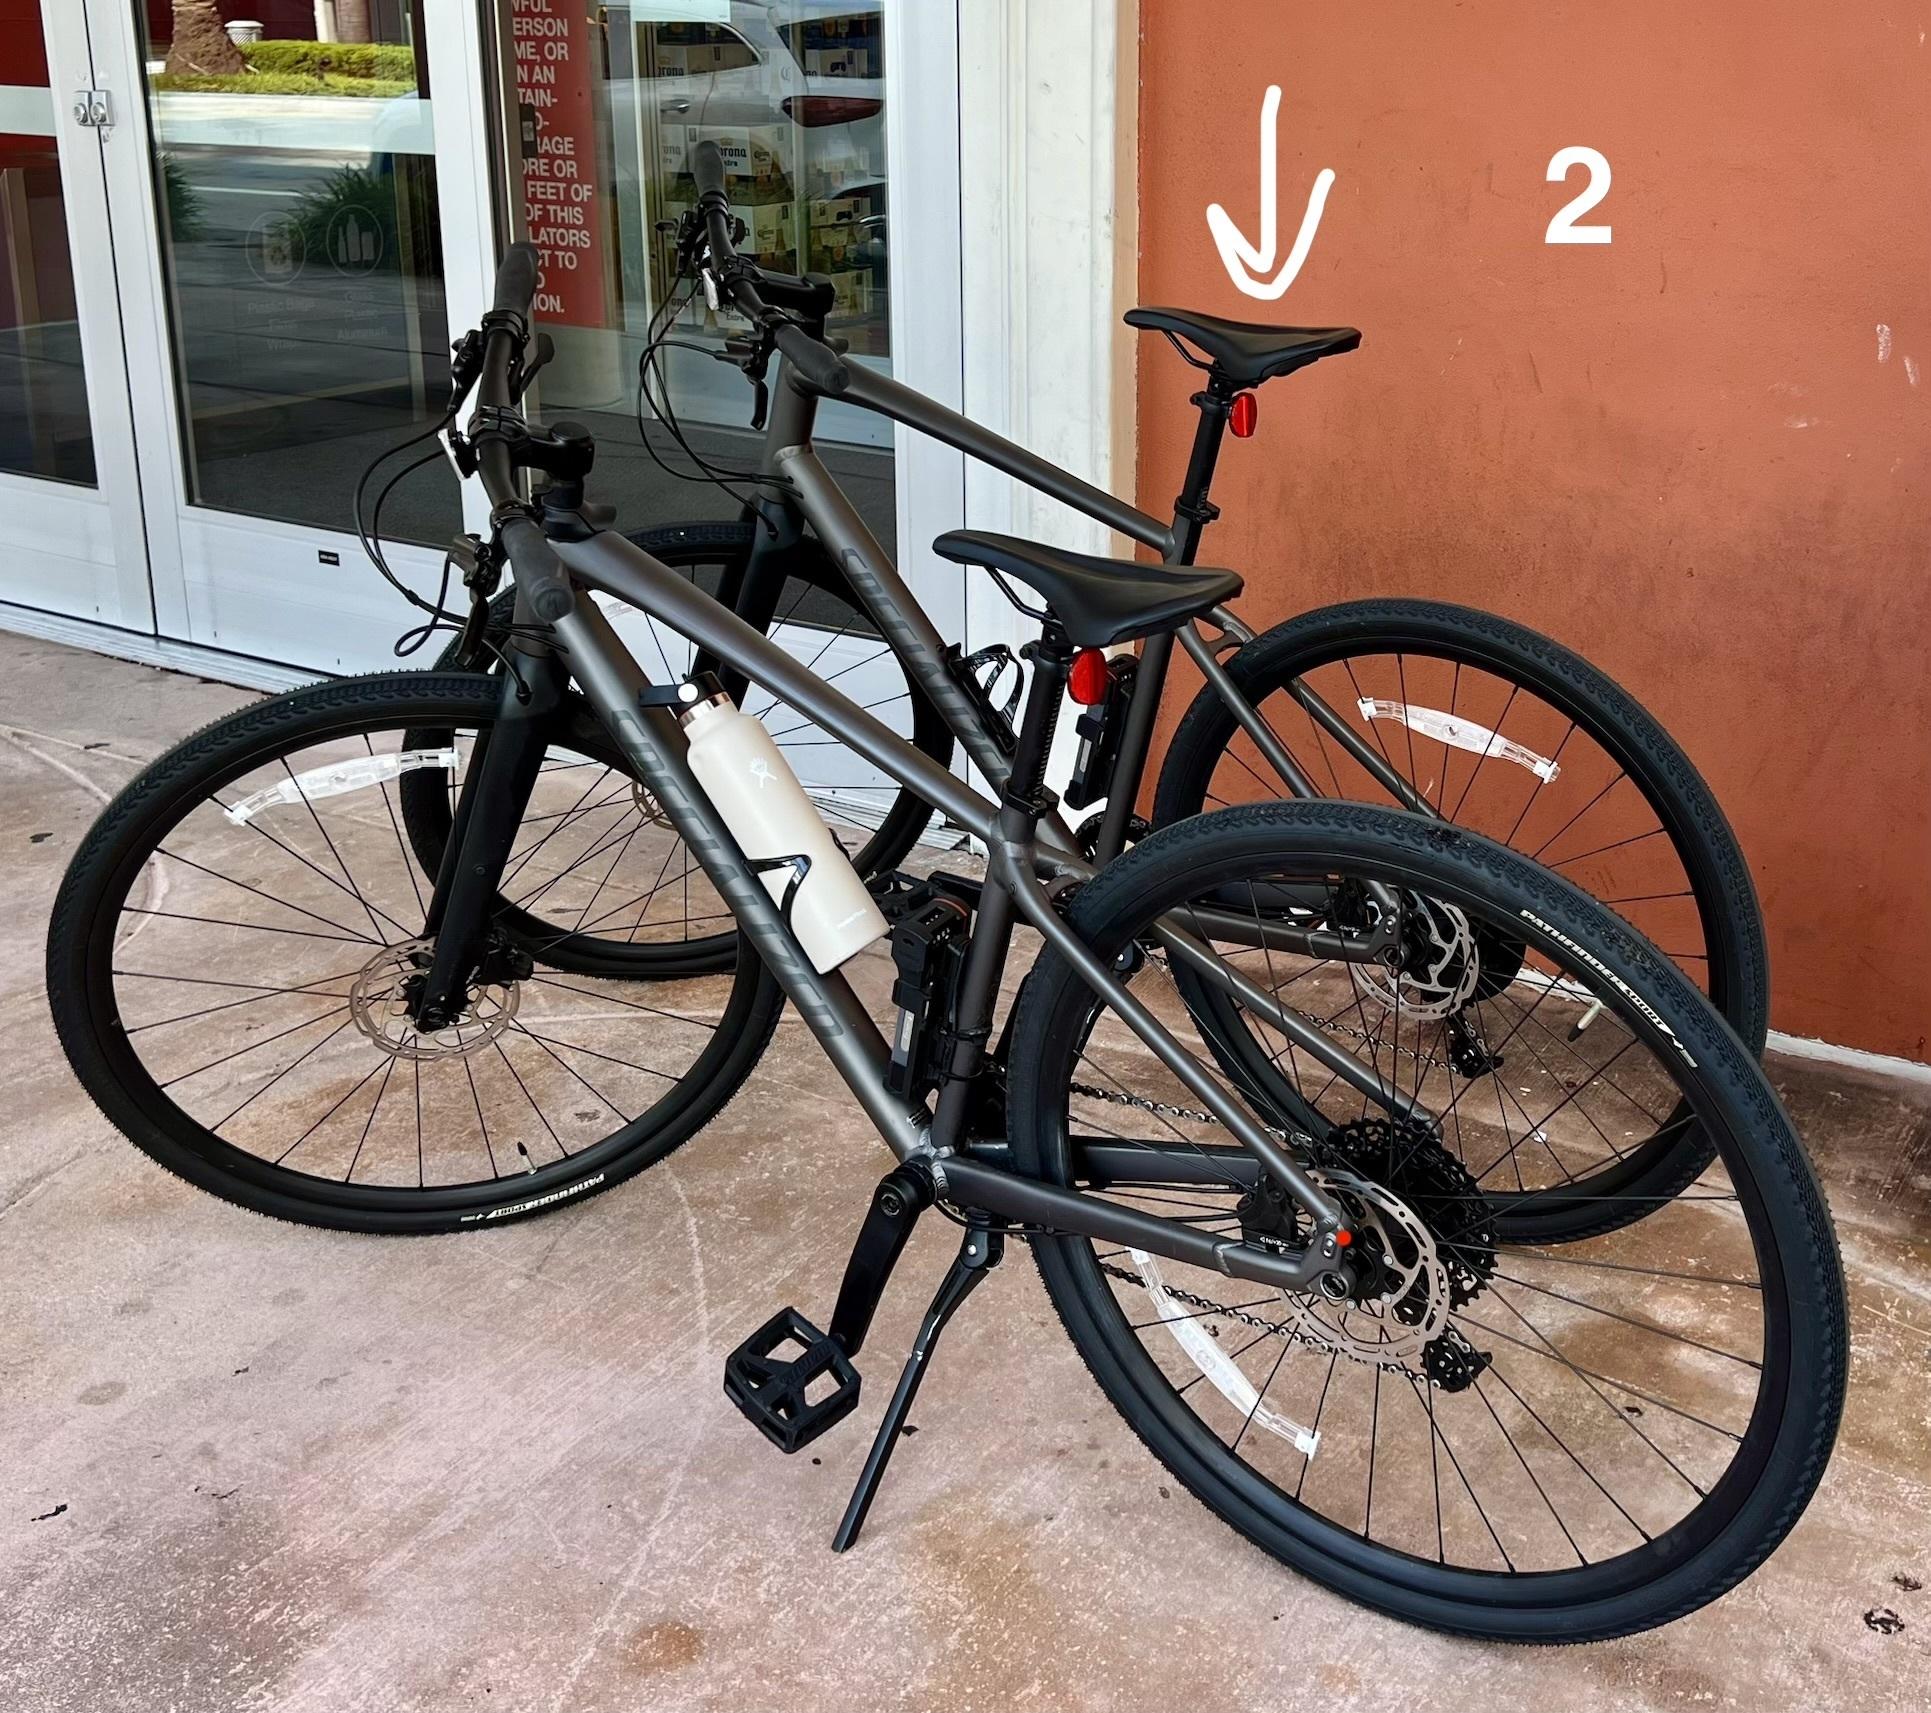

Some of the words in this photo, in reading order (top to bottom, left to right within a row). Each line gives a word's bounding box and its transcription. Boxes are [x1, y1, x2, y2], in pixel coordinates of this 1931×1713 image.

[512, 17, 569, 37] ERSON
[543, 41, 569, 61] OR
[532, 65, 556, 84] AN
[517, 87, 558, 108] TAIN-
[553, 159, 578, 179] OR
[526, 180, 567, 201] FEET
[570, 182, 593, 203] OF
[546, 204, 584, 225] THIS
[528, 226, 592, 249] LATORS
[554, 250, 578, 270] TO
[1519, 909, 1627, 992] PATHFINDER
[1623, 987, 1667, 1028] SPORT
